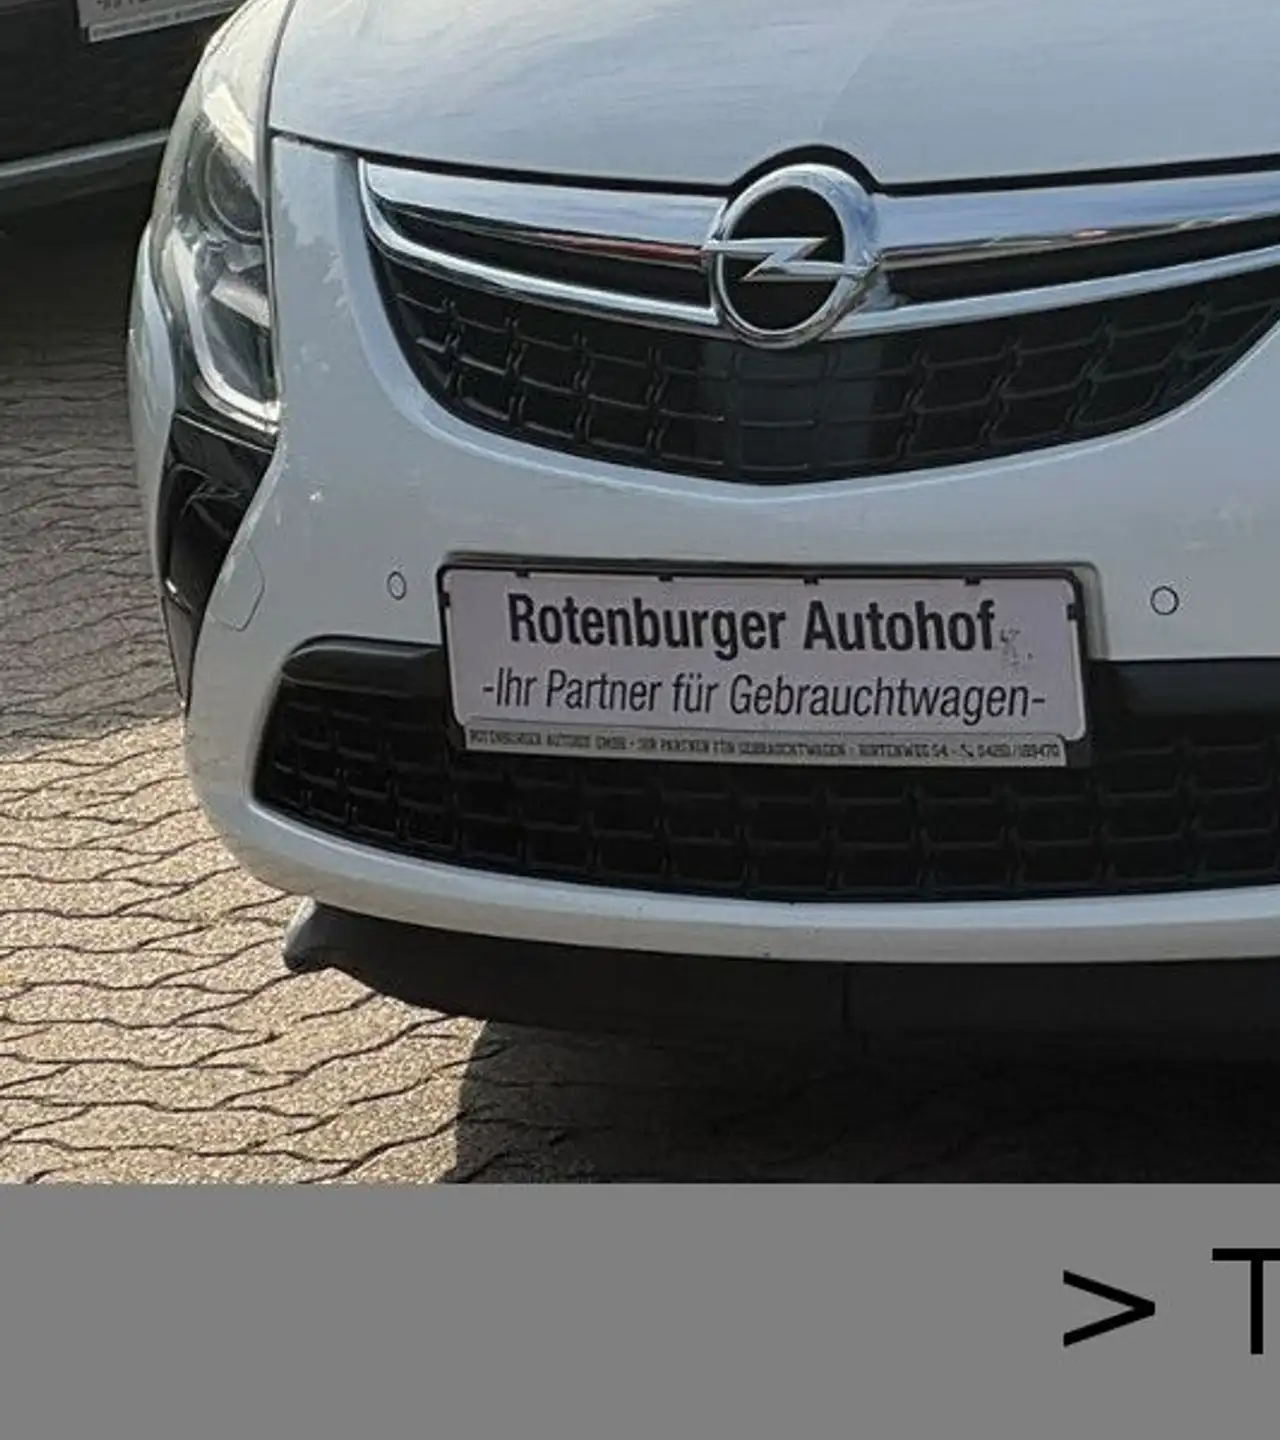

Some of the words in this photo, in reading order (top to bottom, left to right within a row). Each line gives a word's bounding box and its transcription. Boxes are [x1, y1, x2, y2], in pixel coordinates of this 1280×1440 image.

[508, 591, 787, 662] Rotenburger
[802, 598, 997, 653] Autohof
[481, 666, 537, 709] -Ihr
[546, 668, 662, 714] Partner
[672, 670, 719, 715] für
[730, 674, 1047, 728] Gebrauchtwagen-
